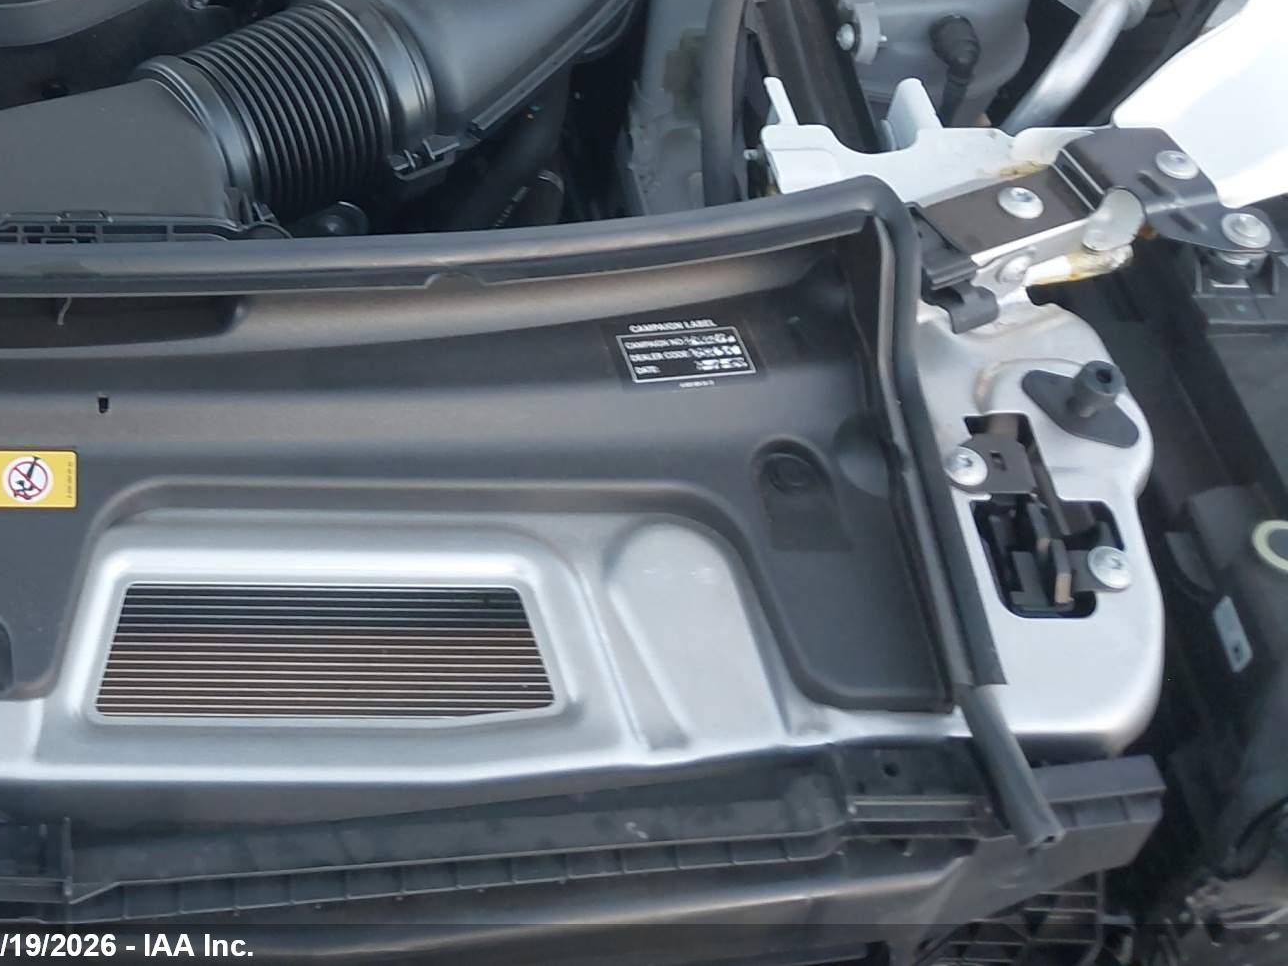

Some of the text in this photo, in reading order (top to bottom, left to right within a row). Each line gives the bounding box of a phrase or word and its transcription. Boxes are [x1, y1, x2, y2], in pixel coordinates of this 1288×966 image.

[629, 319, 717, 333] CAMPAIGN LABEL
[629, 352, 663, 362] DEALER
